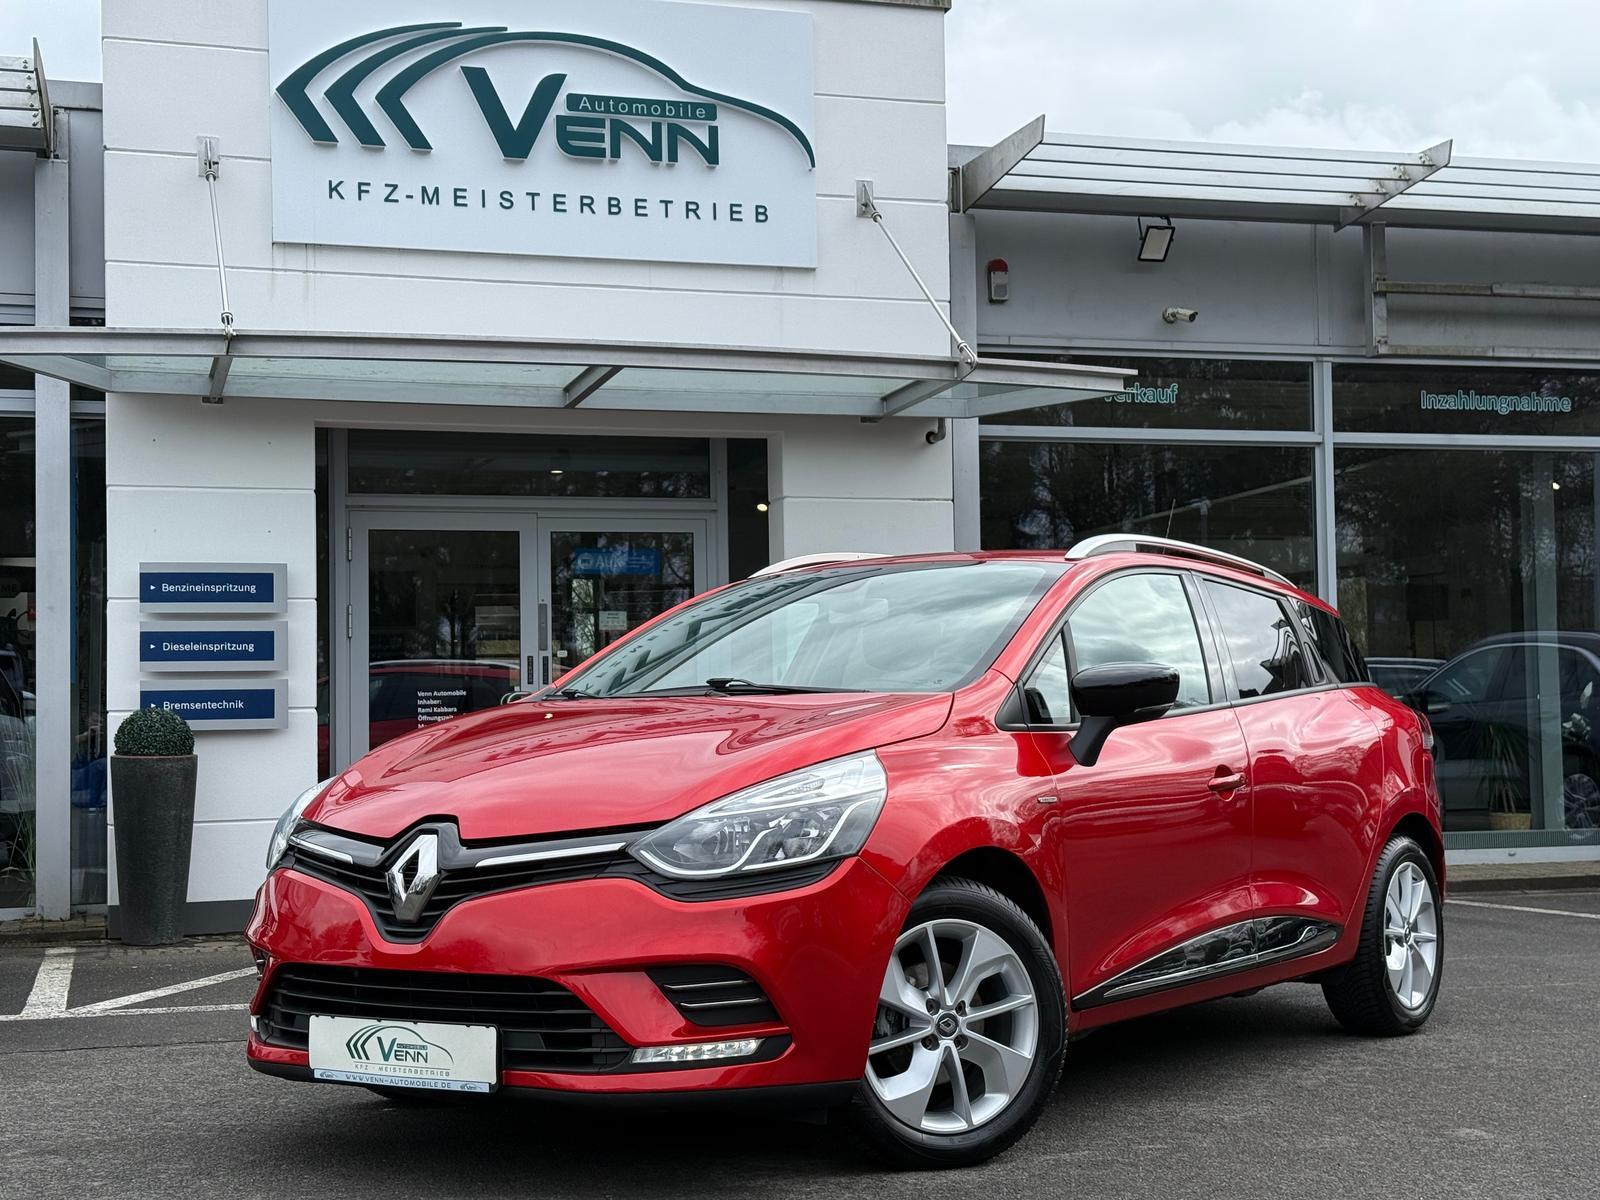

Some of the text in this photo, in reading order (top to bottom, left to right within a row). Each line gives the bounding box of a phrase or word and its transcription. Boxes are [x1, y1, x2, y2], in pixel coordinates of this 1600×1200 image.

[460, 65, 719, 166] VENN
[578, 96, 706, 118] Automobile
[328, 179, 770, 223] KFZ-MEISTERBETRIEB
[1420, 390, 1572, 415] Inzahlungnahme
[161, 583, 257, 594] Benzineinspritzung
[162, 642, 255, 653] Dieseleinspritzung
[163, 700, 244, 711] Bremsentechnik
[377, 1036, 428, 1063] VENN
[355, 1063, 368, 1071] KFZ
[378, 1066, 450, 1077] MEISTERBETRIEB
[345, 1074, 451, 1089] WWW.VENN-AUTOMOBILE.DE
